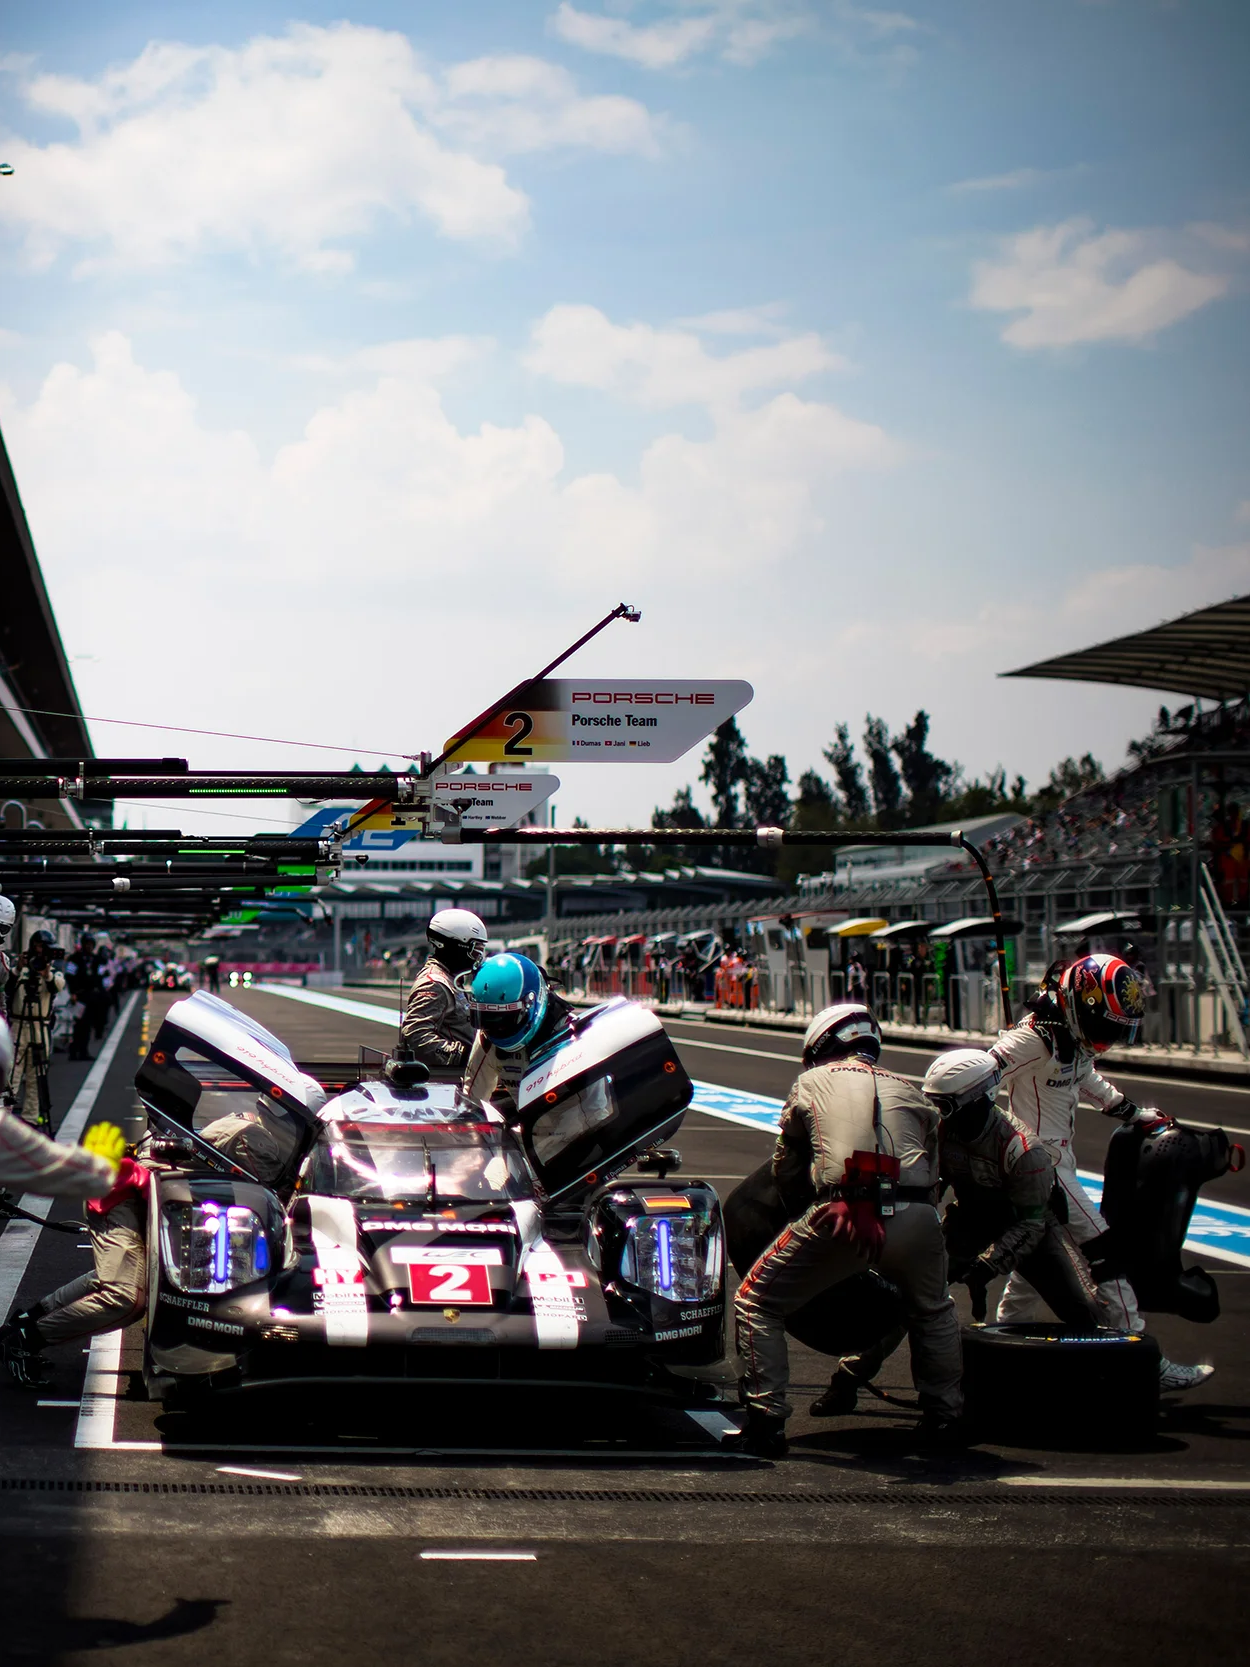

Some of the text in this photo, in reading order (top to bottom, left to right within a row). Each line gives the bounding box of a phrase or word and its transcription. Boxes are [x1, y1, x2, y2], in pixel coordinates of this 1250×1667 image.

[571, 692, 715, 705] PORSCHE
[571, 714, 658, 727] Porsche Team
[502, 710, 534, 757] 2
[435, 783, 533, 791] PORSCHE
[471, 797, 494, 807] Team
[811, 1030, 831, 1055] uvex
[830, 1066, 868, 1074] DMG
[526, 1076, 544, 1092] 919
[362, 1221, 517, 1235] DMG MORI
[422, 1250, 487, 1258] WEC
[316, 1268, 361, 1285] HY
[428, 1264, 472, 1301] 2
[159, 1291, 211, 1313] SCHAEFFLER
[533, 1295, 570, 1303] Mobil
[187, 1316, 245, 1336] DMG MORI
[655, 1324, 703, 1342] DMG MORI
